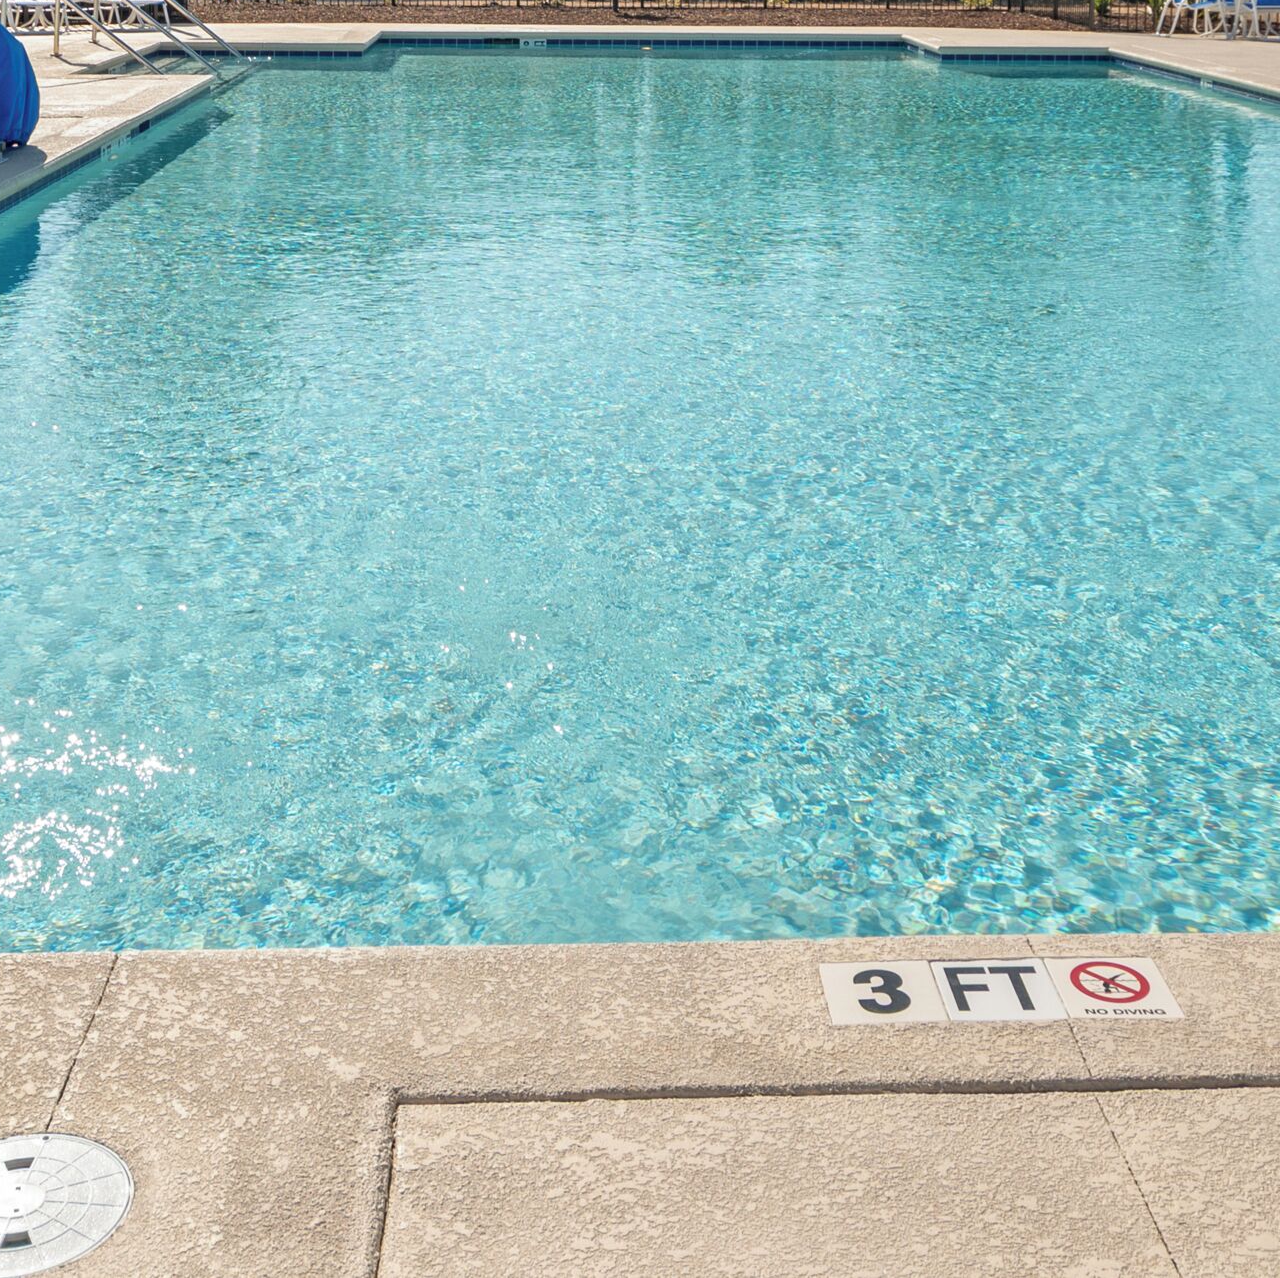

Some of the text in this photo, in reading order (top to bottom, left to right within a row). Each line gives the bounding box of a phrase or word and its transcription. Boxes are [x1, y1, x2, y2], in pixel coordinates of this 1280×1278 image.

[853, 966, 1037, 1015] 3 FT
[1084, 1007, 1168, 1017] NO DIVING
